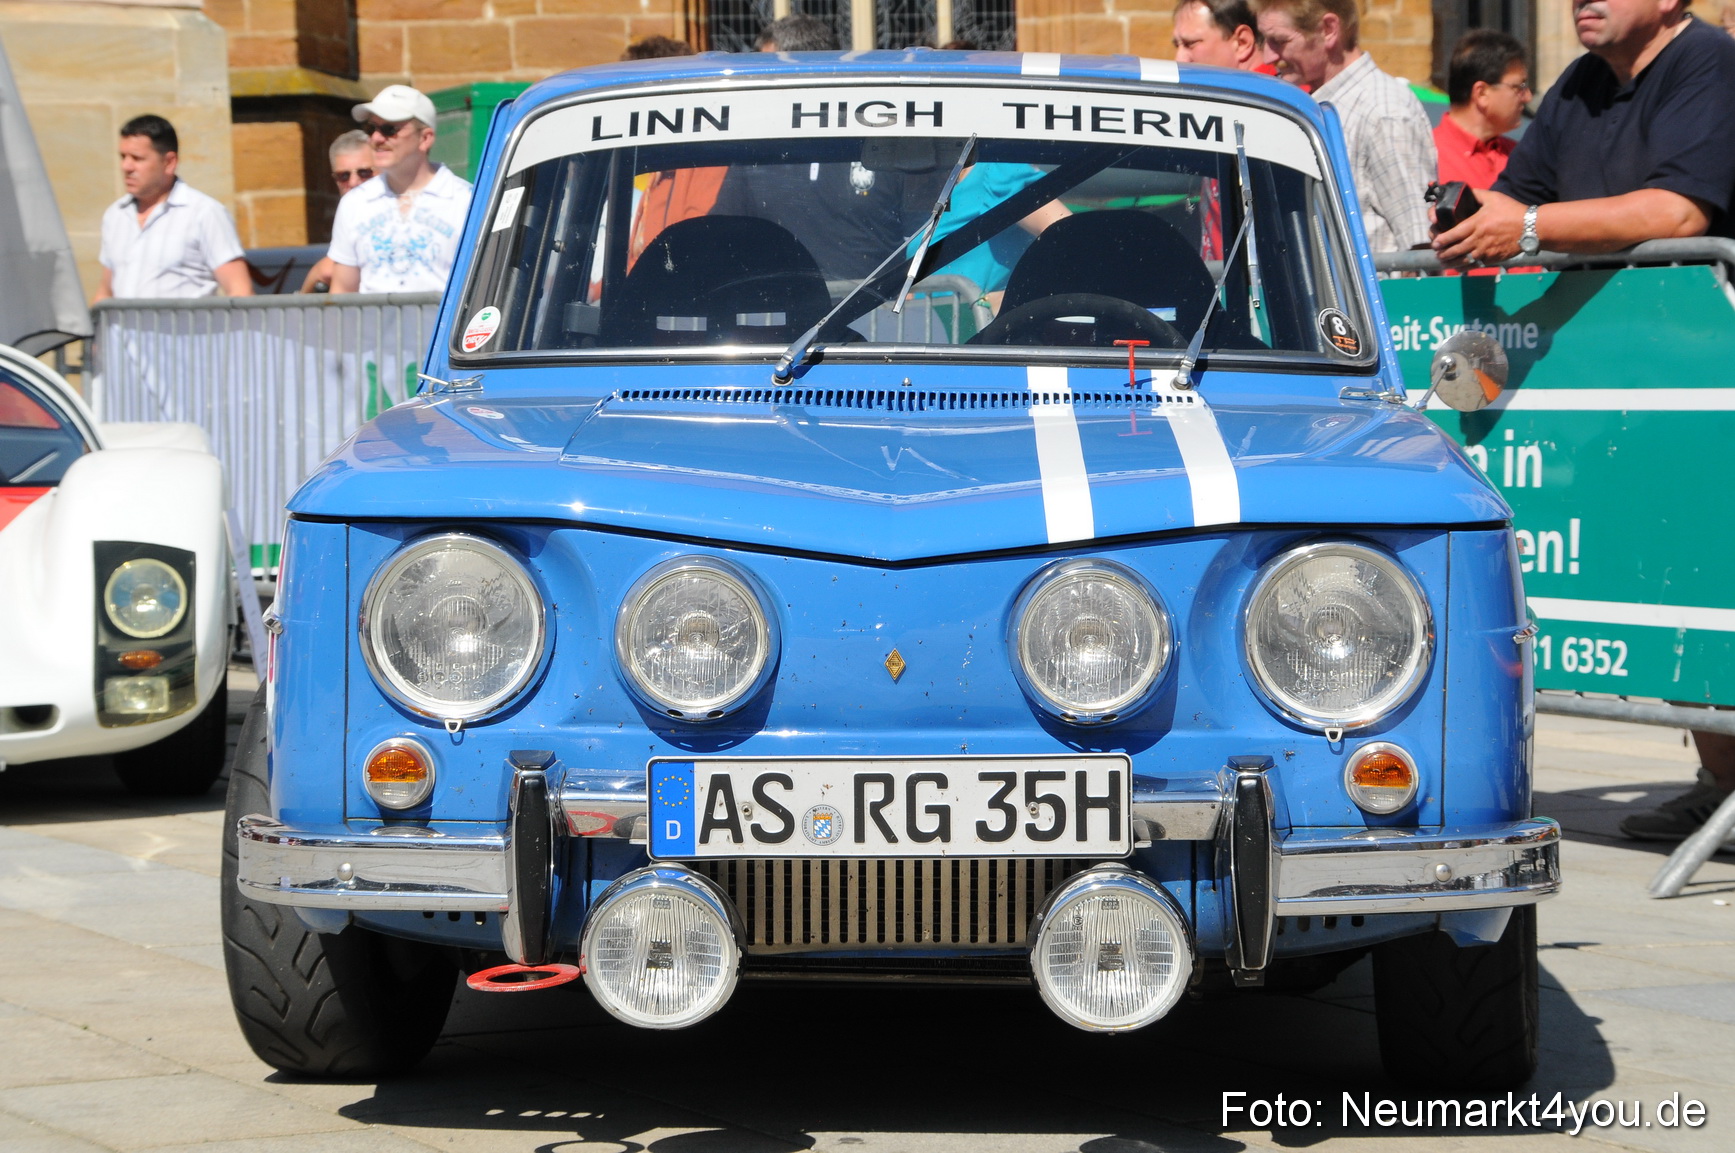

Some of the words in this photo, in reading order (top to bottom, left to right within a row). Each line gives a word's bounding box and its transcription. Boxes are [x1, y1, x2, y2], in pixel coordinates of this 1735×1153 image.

[591, 105, 730, 142] LINN
[791, 100, 944, 129] HIGH
[1002, 102, 1224, 143] THERM
[1332, 316, 1347, 336] 8
[1503, 429, 1543, 488] in
[1561, 637, 1629, 676] 6352
[698, 771, 796, 845] AS
[853, 771, 952, 844] RG
[974, 770, 1121, 843] 35H
[665, 819, 681, 840] D
